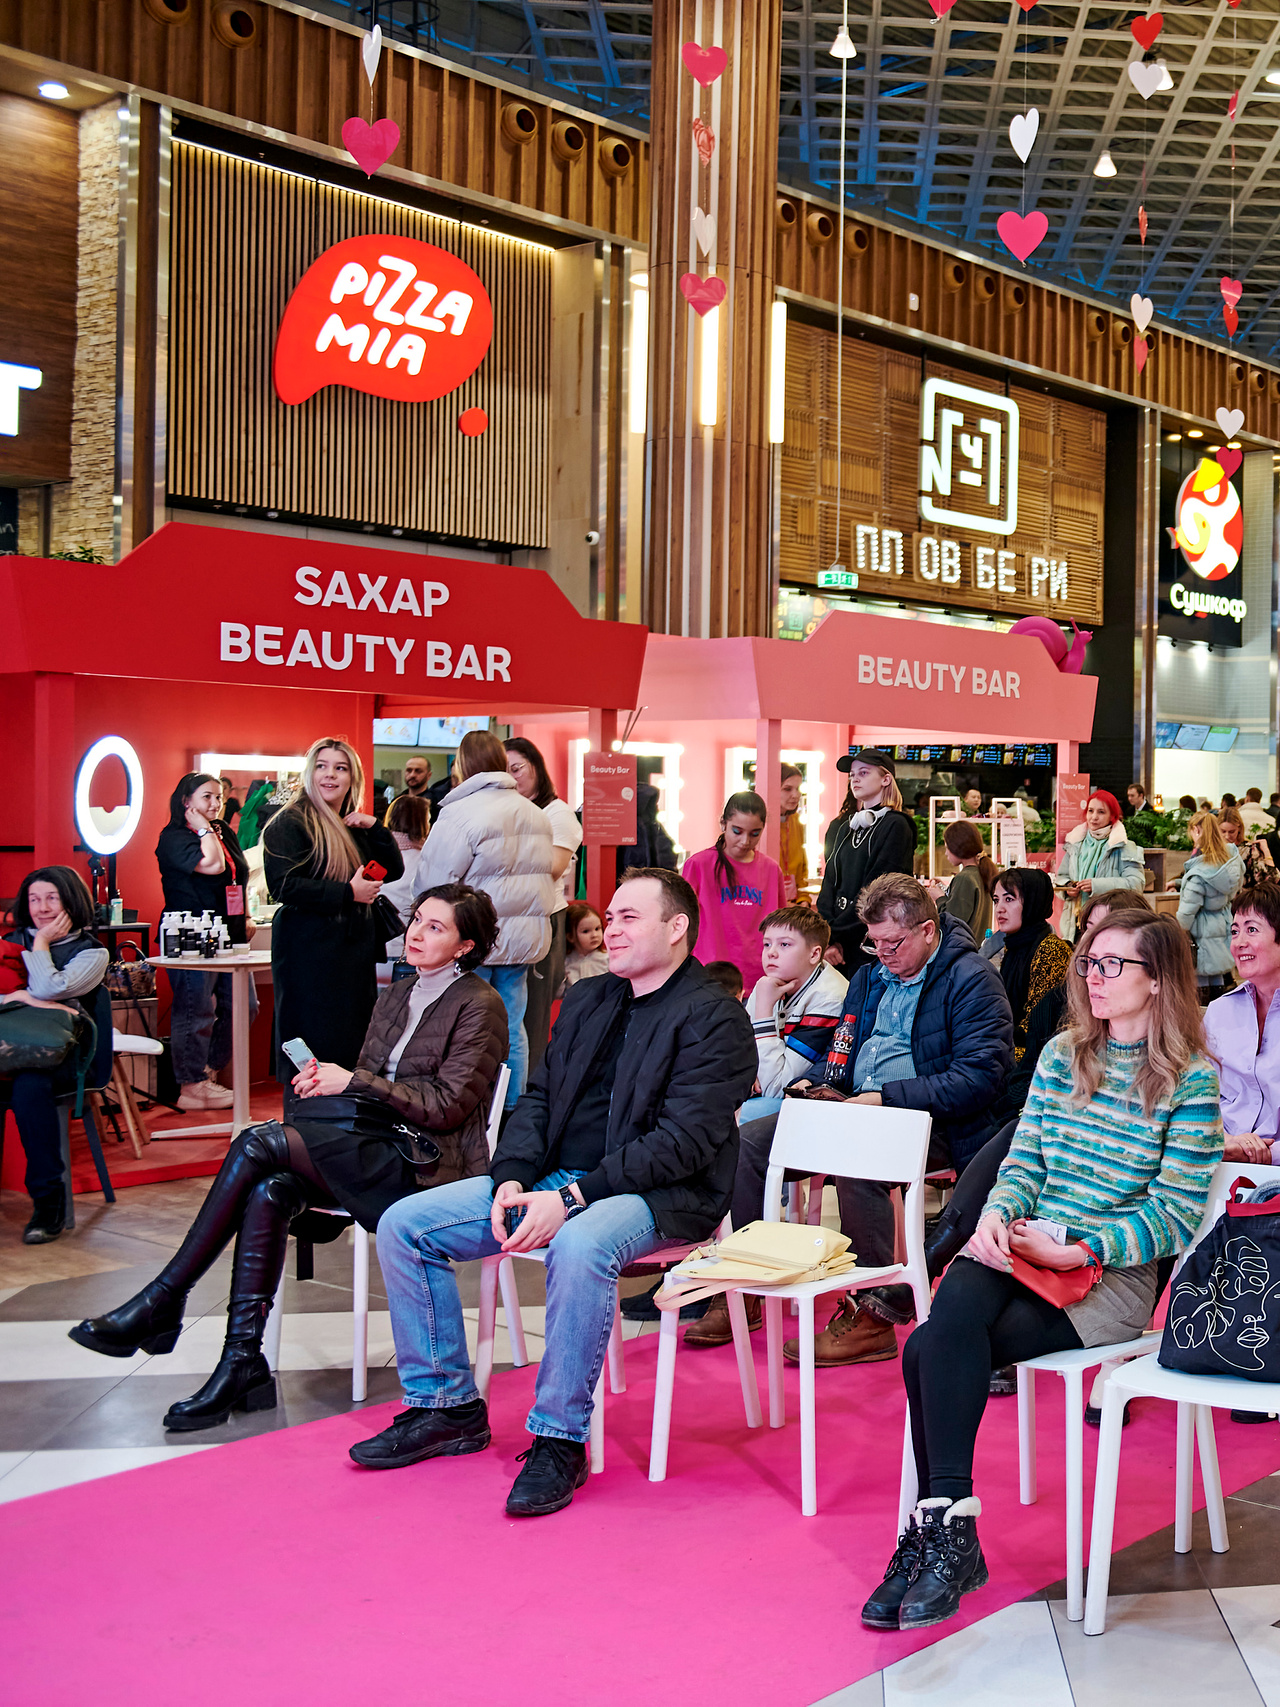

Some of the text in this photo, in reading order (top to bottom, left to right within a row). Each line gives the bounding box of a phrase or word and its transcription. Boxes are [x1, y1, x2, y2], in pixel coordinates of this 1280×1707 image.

[330, 255, 474, 336] PIZZA
[316, 313, 427, 376] MIA
[294, 566, 450, 617] SAXAP
[1169, 583, 1248, 624] Сушкоф
[220, 621, 512, 682] BEAUTY BAR
[858, 654, 1021, 699] BEAUTY BAR
[590, 765, 630, 775] Beauty Bar
